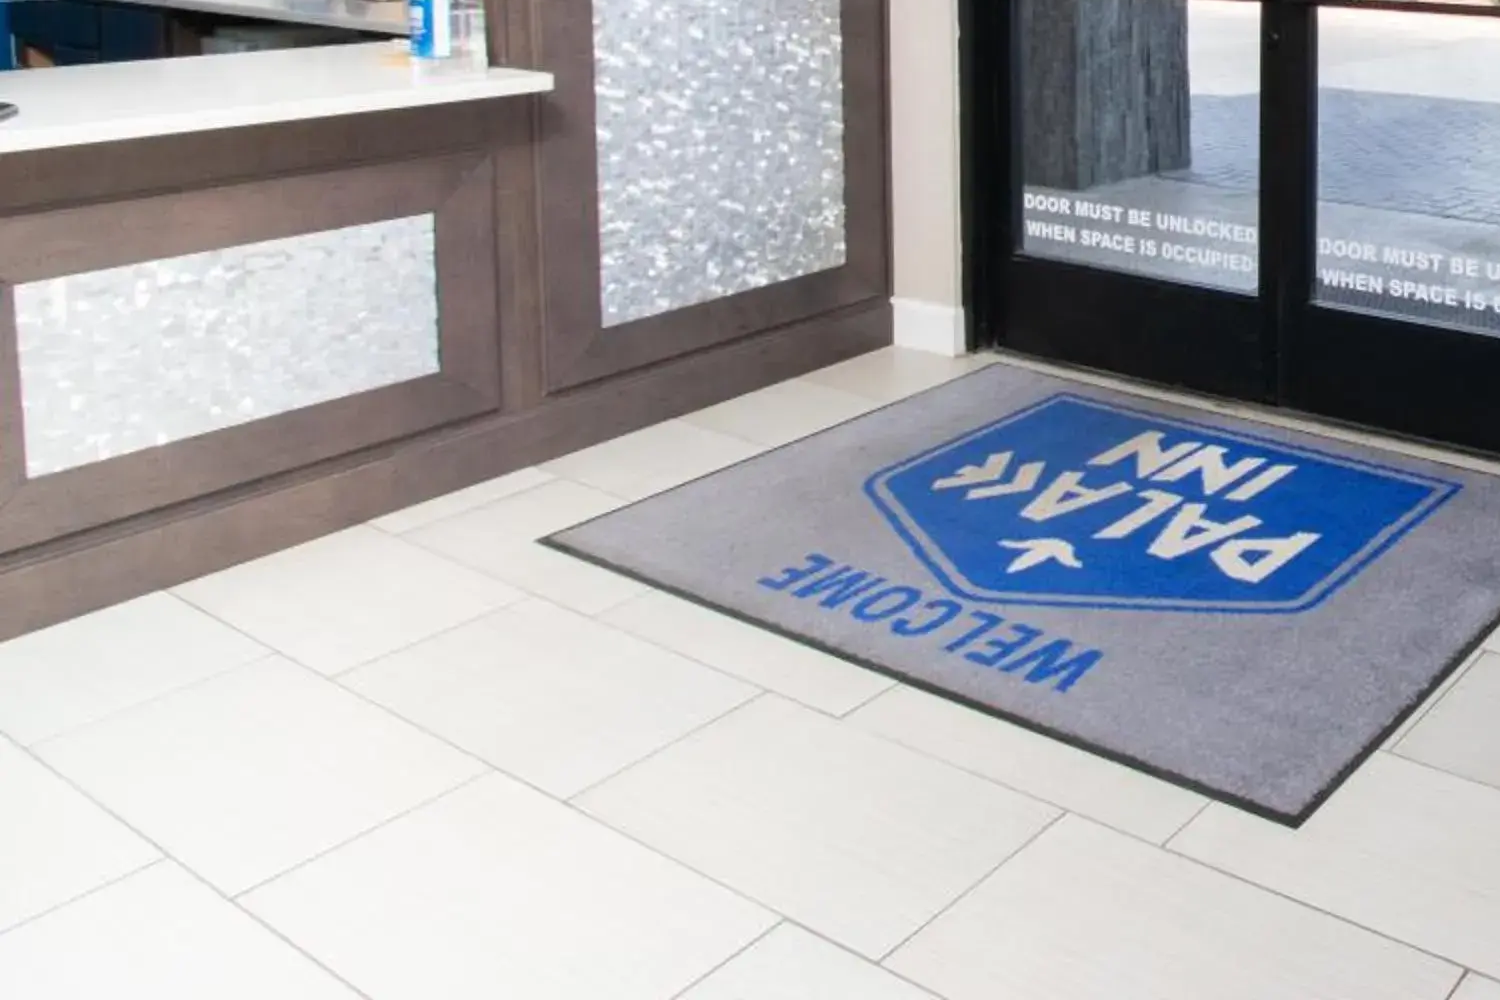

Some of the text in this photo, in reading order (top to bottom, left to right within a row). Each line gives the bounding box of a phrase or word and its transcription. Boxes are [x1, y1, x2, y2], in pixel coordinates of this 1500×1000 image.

[1024, 192, 1259, 244] DOOR MUST BE UNLOCKED
[1025, 219, 1076, 243] WHEN
[1080, 229, 1135, 254] SPACE
[1139, 238, 1157, 257] IS
[1318, 238, 1378, 264] DOOR
[1382, 245, 1443, 273] MUST
[1450, 256, 1480, 278] BE
[1319, 268, 1383, 294] WHEN
[1389, 278, 1458, 307] SPACE
[1464, 290, 1487, 312] IS
[1086, 429, 1299, 502] INN
[757, 552, 1105, 695] WELCOME
